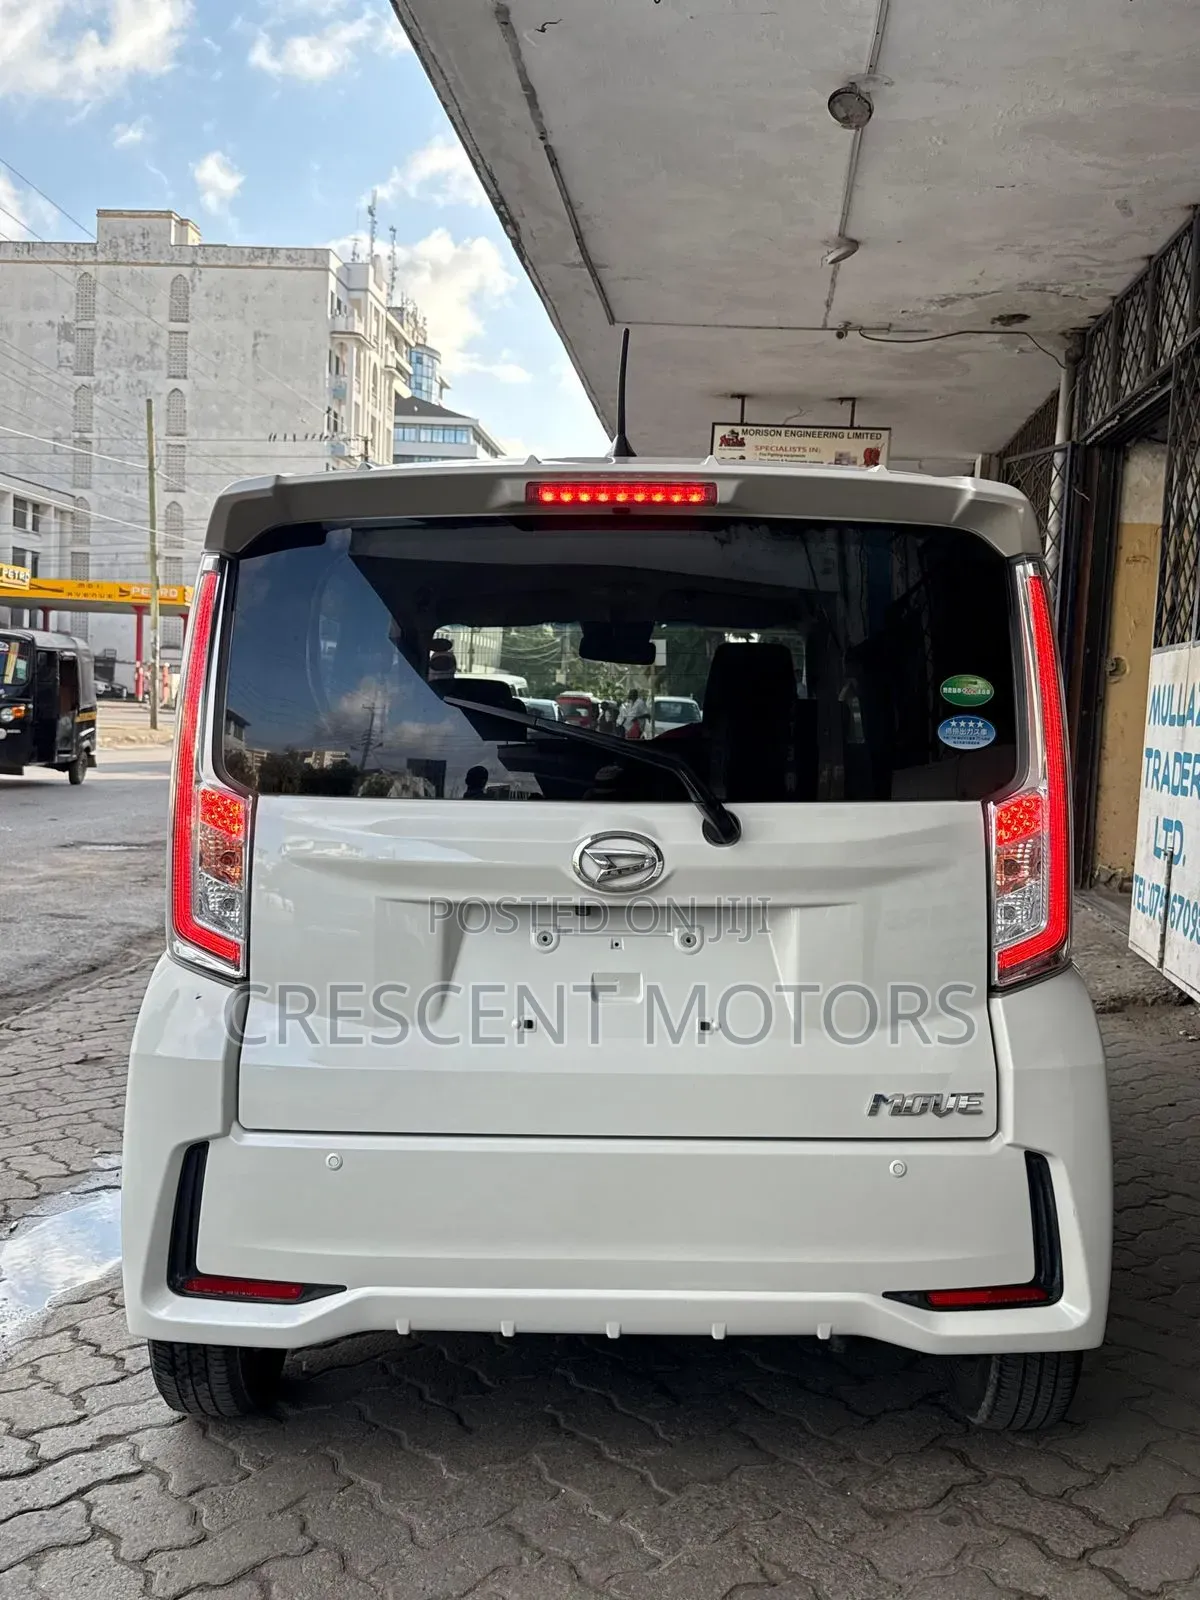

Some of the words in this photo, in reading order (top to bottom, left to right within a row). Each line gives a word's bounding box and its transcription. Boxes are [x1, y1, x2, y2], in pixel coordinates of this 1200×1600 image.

[741, 428, 782, 437] MORISON
[784, 430, 845, 439] ENGINEERING
[847, 432, 882, 440] LIMITED
[754, 445, 807, 453] SPECIALISTS
[131, 586, 179, 598] PERO
[867, 1092, 984, 1118] MOVE
